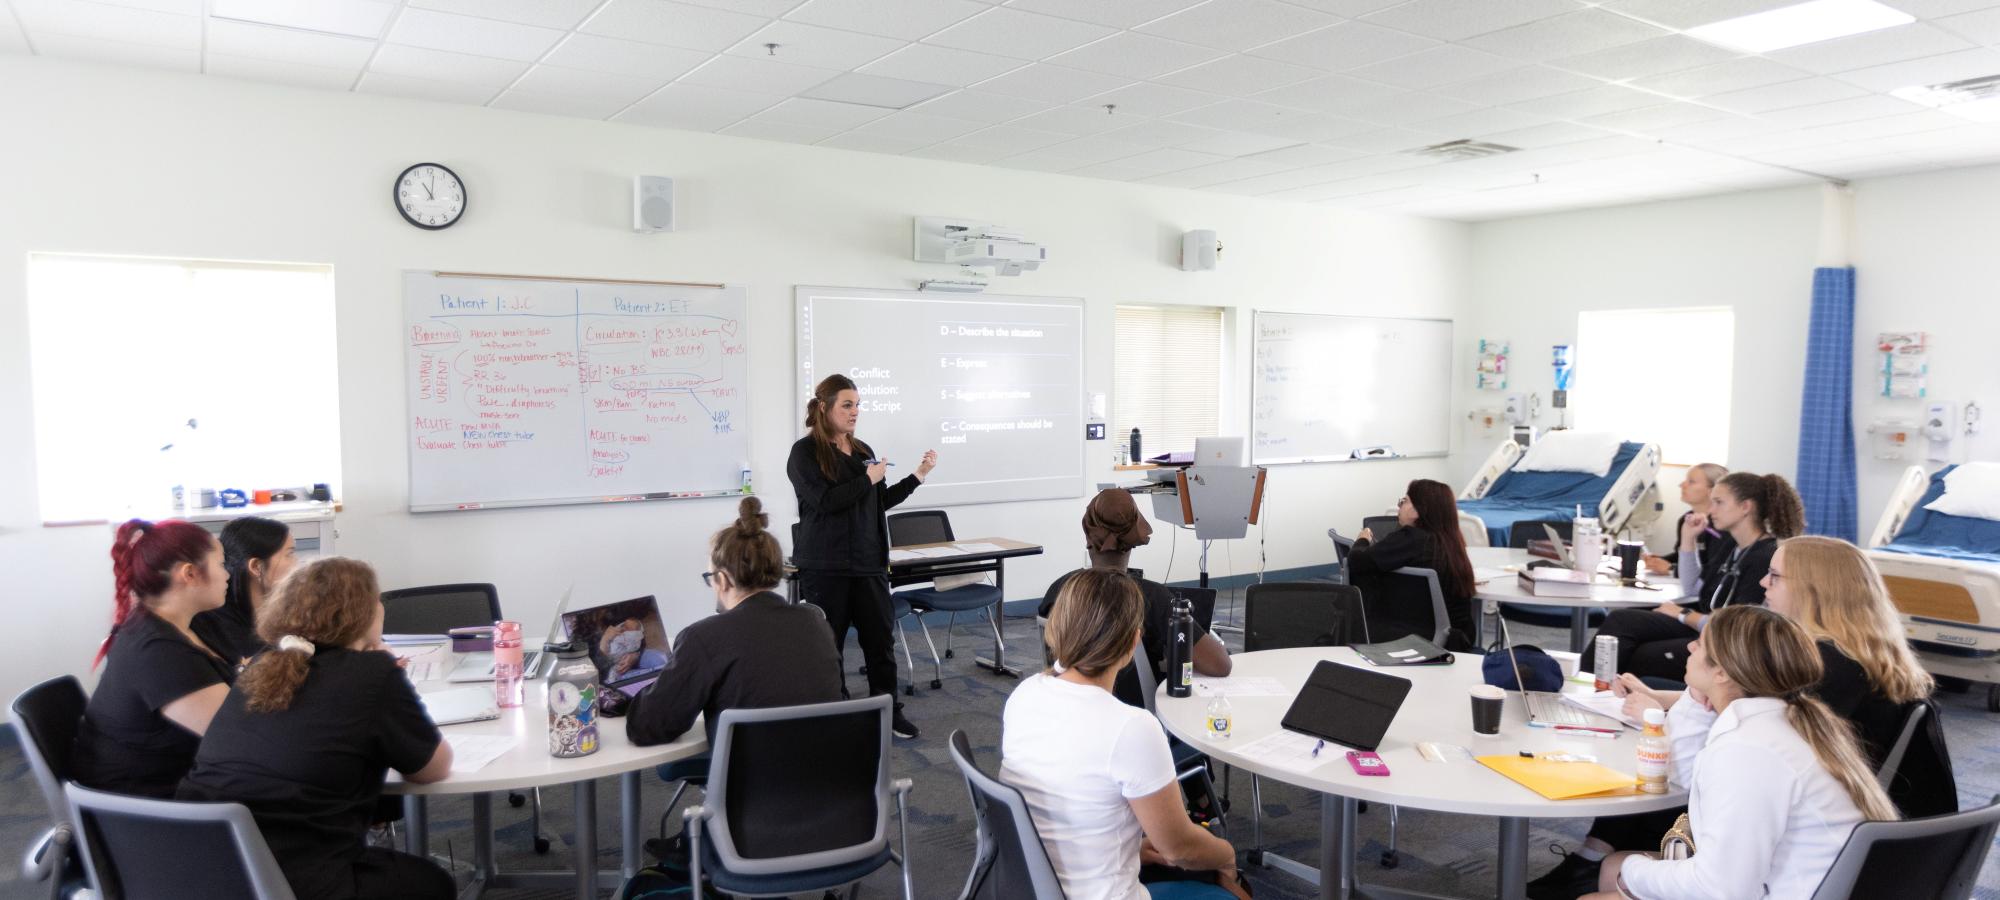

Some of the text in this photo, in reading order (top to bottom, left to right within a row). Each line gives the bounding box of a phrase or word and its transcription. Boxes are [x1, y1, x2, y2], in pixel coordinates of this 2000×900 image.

[440, 294, 489, 311] Patient
[614, 297, 655, 313] Patient
[940, 325, 949, 336] D
[958, 326, 994, 337] Describe
[996, 326, 1010, 337] the
[1011, 328, 1044, 338] situation
[940, 357, 948, 368] E
[956, 357, 989, 371] Express
[850, 367, 891, 379] Conflict
[872, 400, 902, 414] Script
[941, 421, 950, 432] C
[958, 420, 1016, 433] Consequences
[1017, 419, 1042, 430] should
[1043, 419, 1053, 429] be
[941, 433, 967, 444] stated
